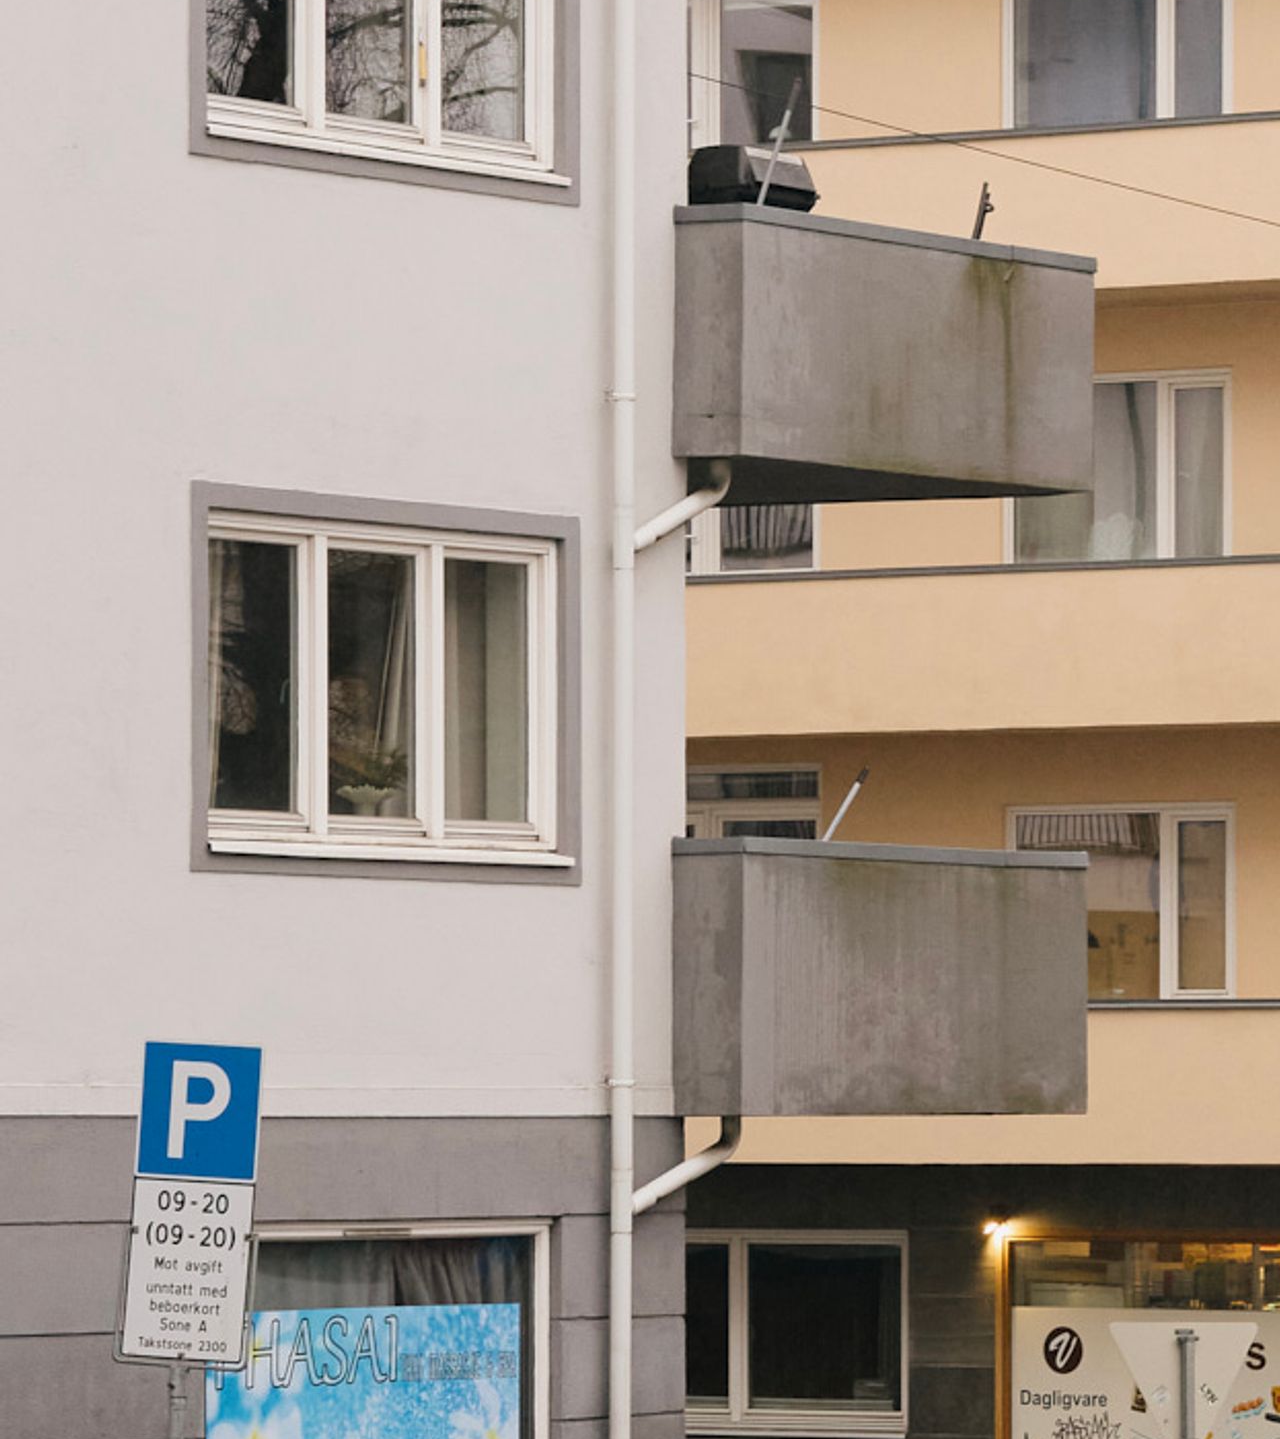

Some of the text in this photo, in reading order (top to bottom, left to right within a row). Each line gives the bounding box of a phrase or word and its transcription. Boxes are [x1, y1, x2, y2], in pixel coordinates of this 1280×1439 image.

[166, 1059, 231, 1159] P
[154, 1256, 223, 1275] Mot avgift
[146, 1283, 227, 1298] unntatt med
[160, 1317, 207, 1333] Sone A
[138, 1336, 228, 1353] Takstsone 2300
[214, 1314, 399, 1390] HASAI
[1020, 1389, 1108, 1410] Dagligvare
